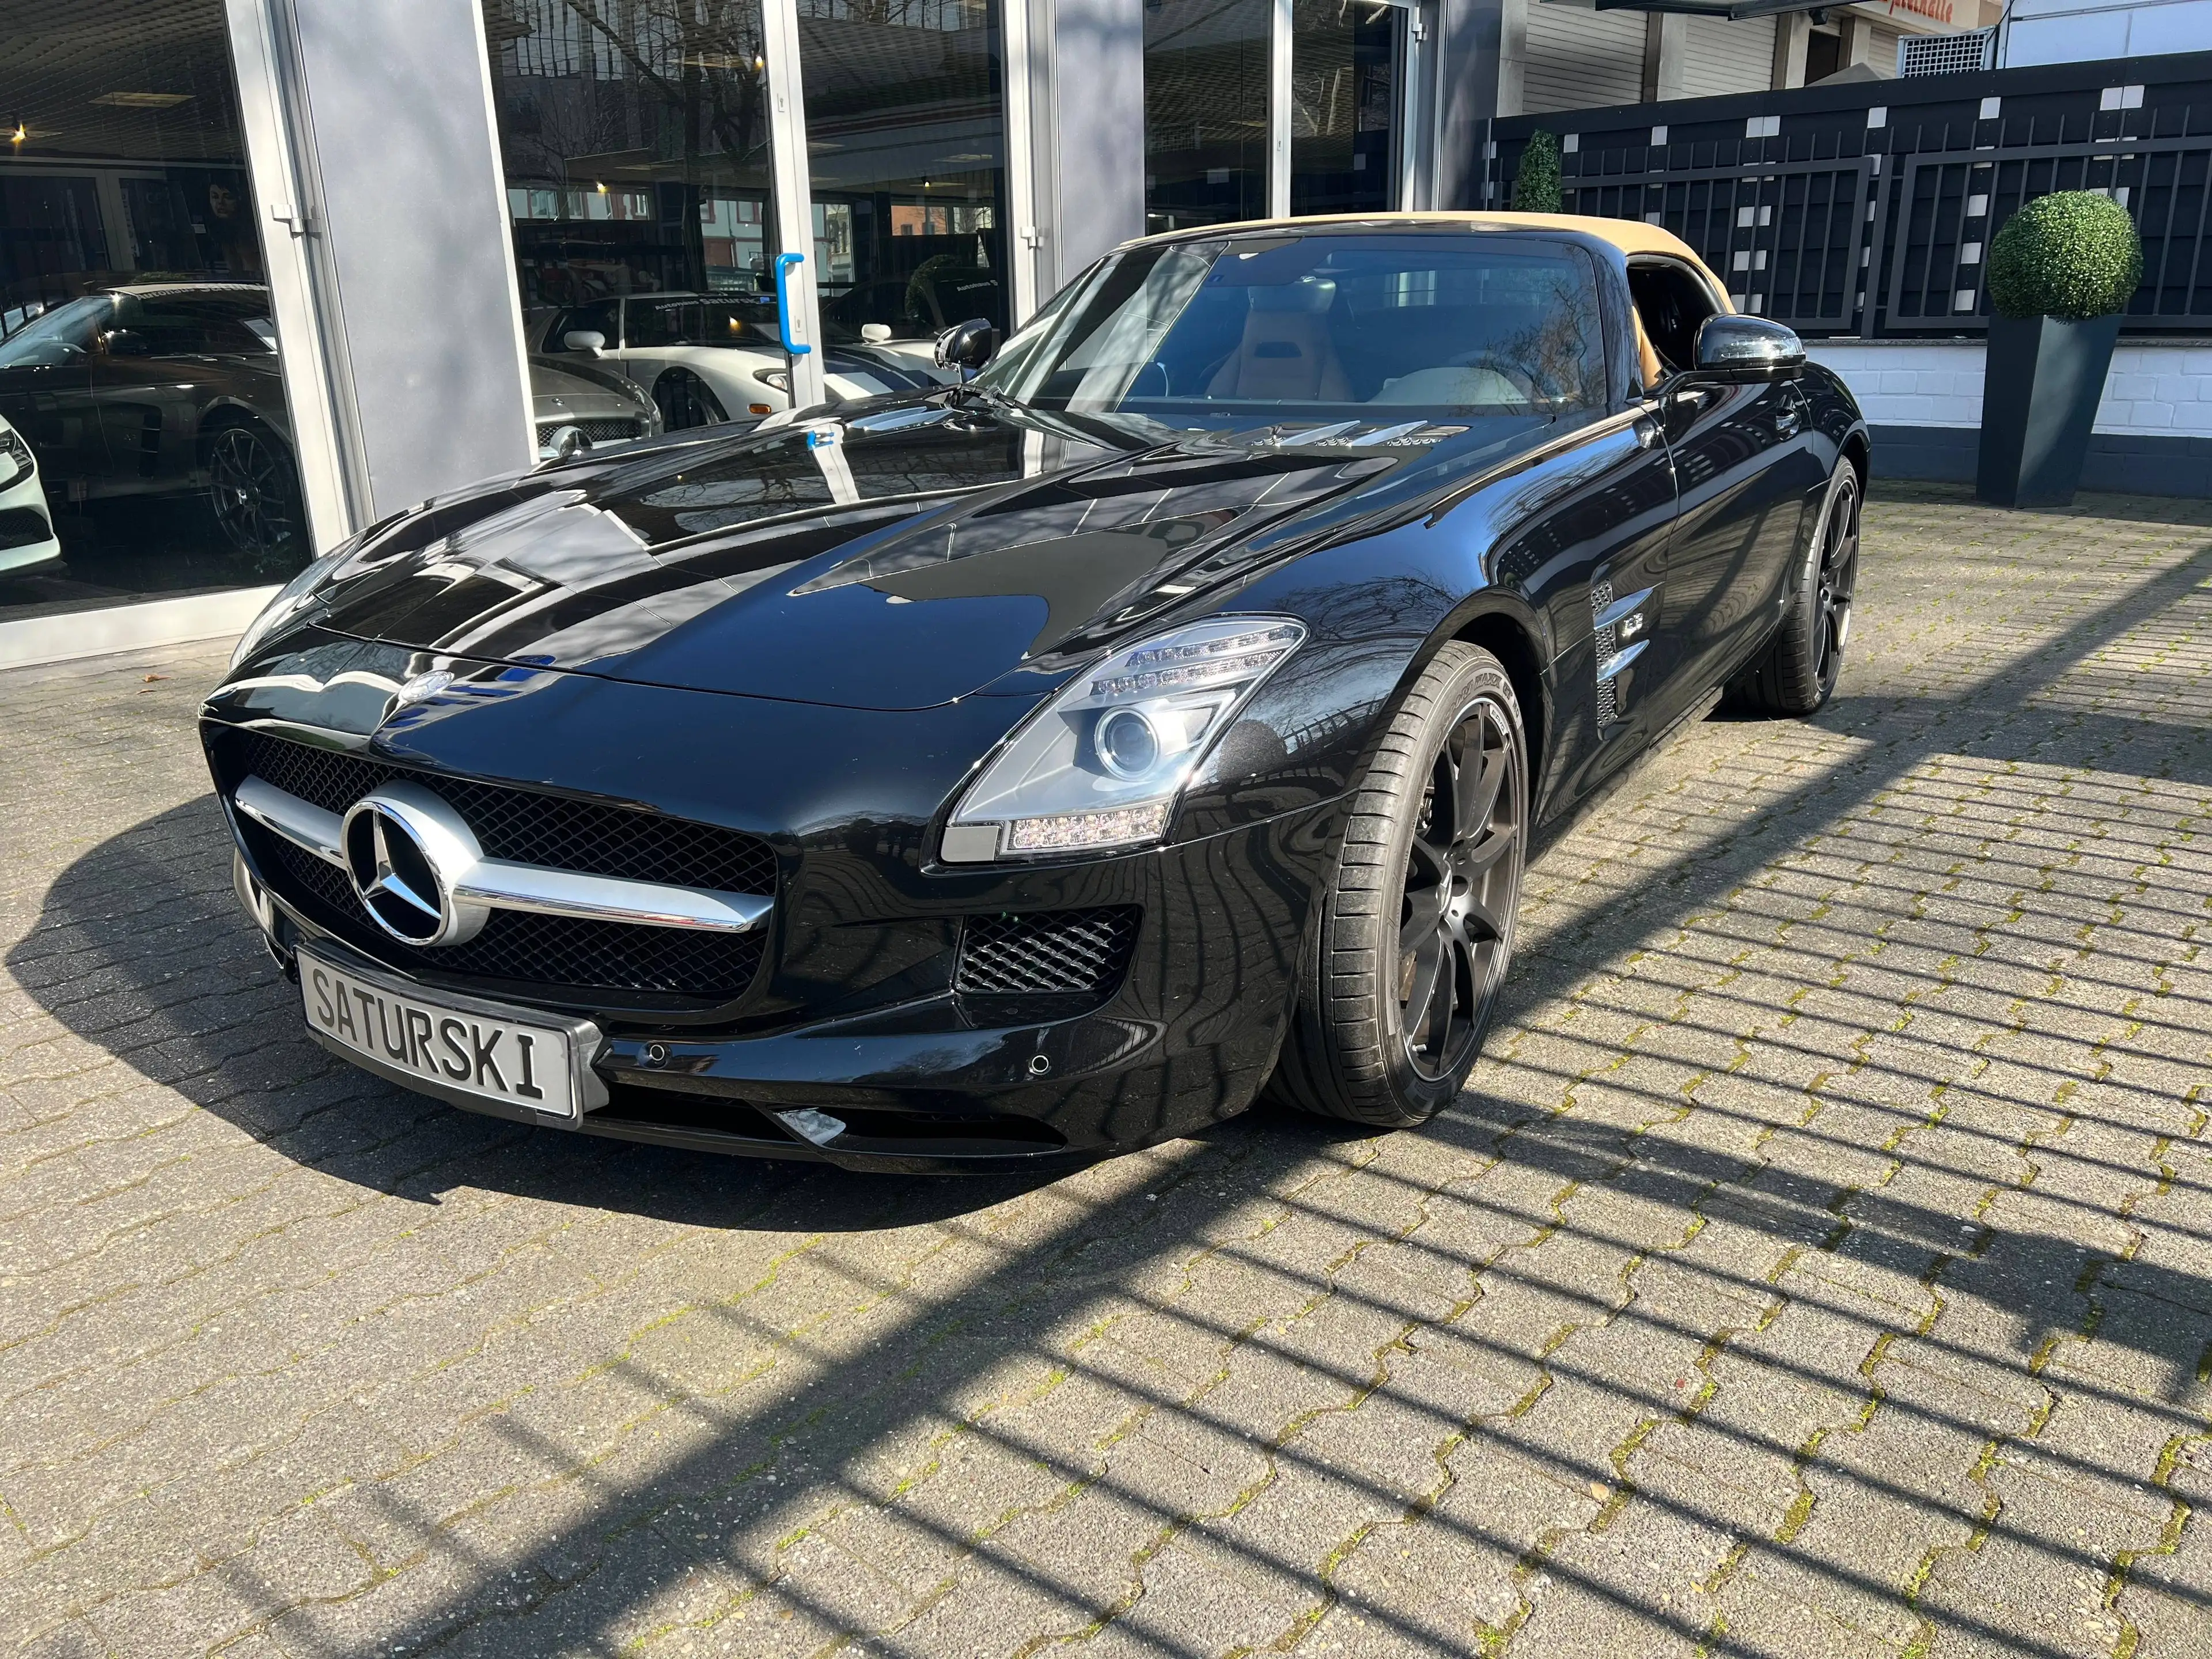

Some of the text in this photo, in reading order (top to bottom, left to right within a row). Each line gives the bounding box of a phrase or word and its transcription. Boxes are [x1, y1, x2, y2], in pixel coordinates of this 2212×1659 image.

[1474, 673, 1502, 690] MAXX
[1503, 681, 1513, 700] GT
[312, 968, 543, 1099] SATURSKI
